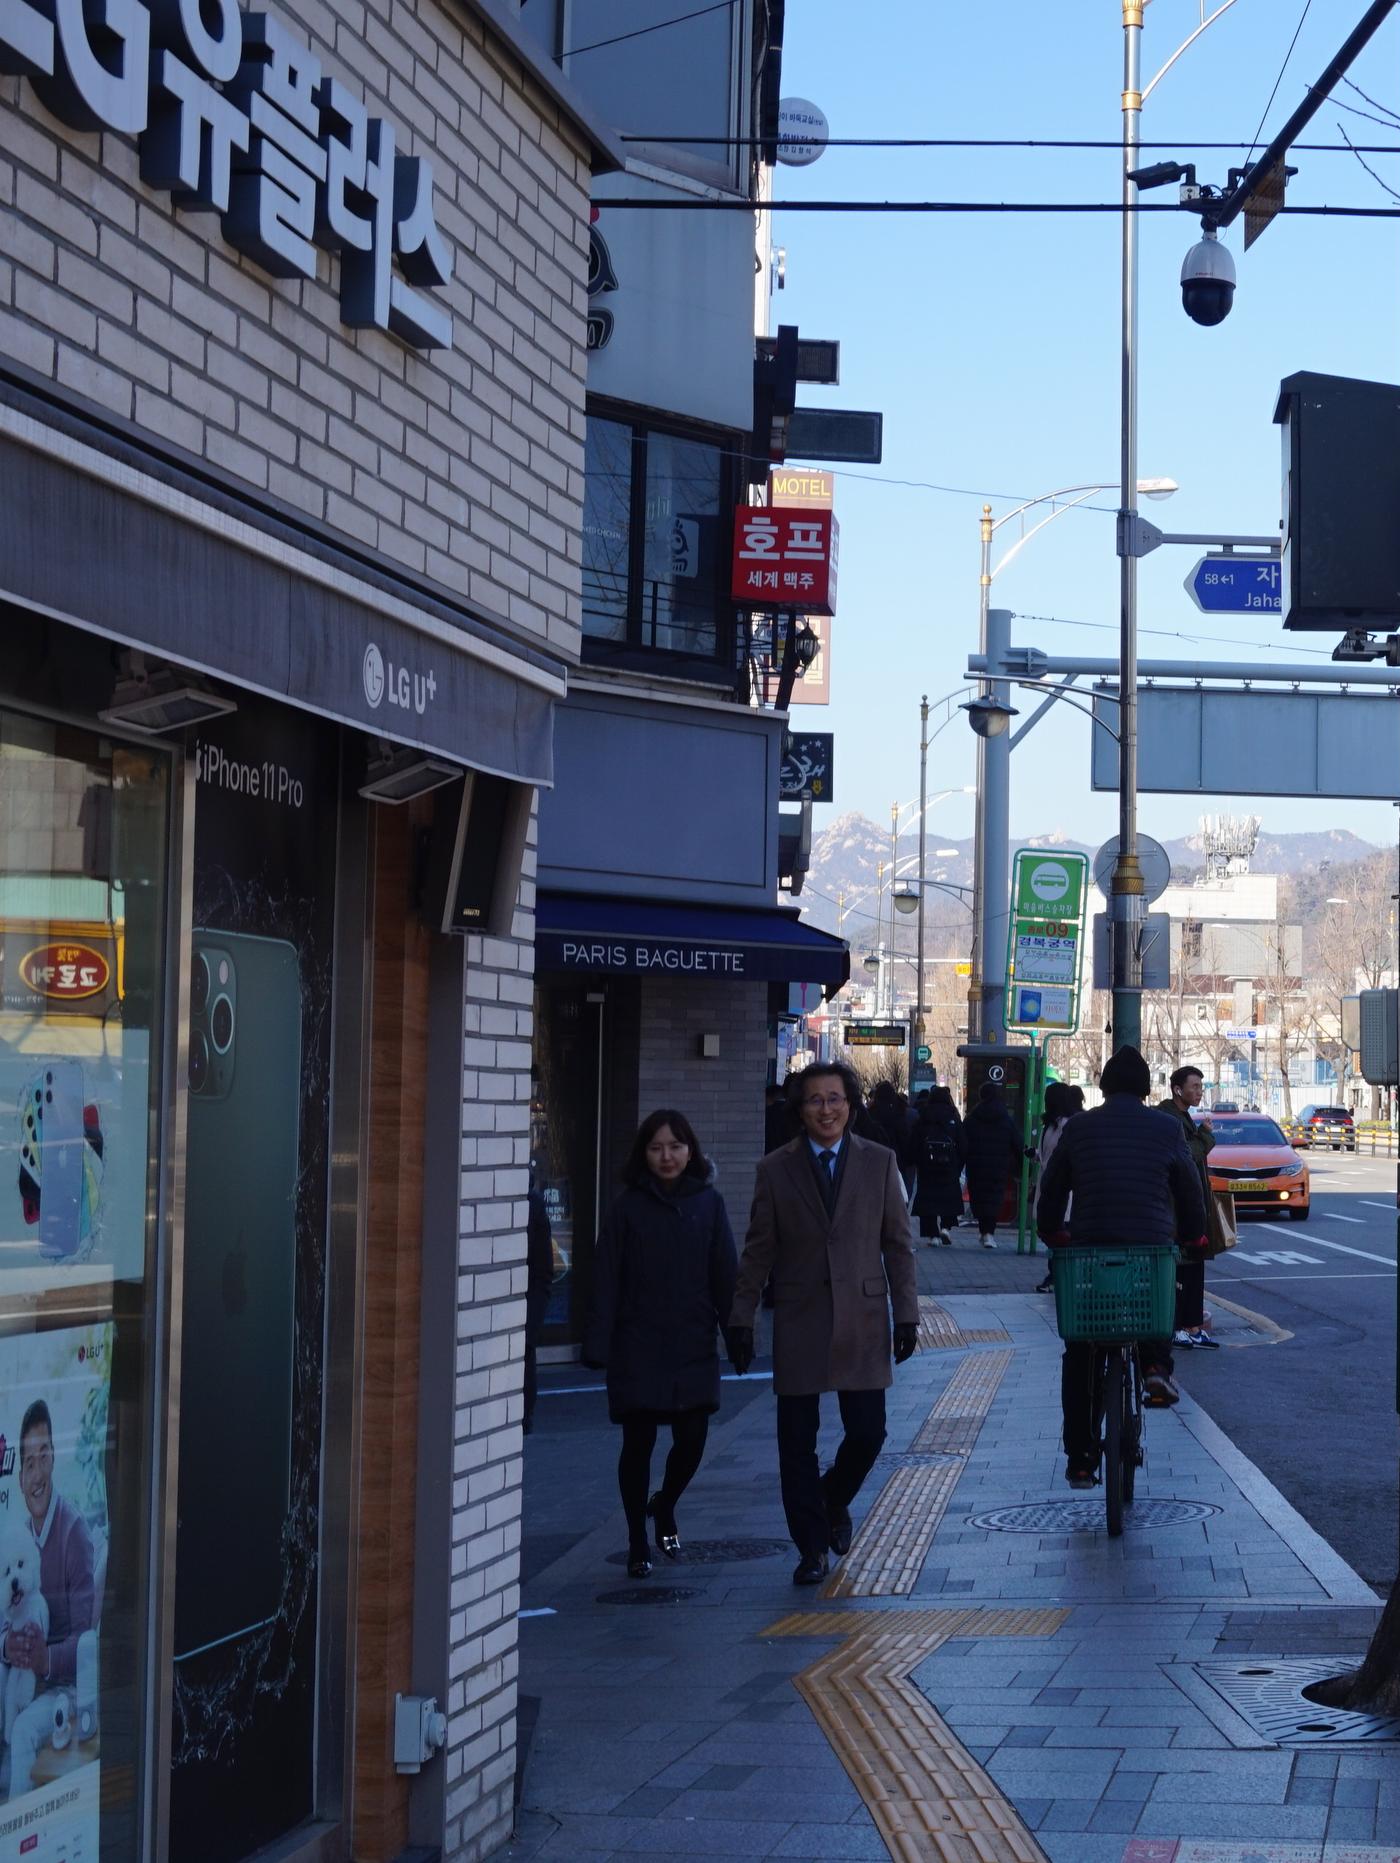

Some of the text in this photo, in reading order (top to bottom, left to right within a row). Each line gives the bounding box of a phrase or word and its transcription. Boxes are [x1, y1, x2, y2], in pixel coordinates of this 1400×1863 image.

[773, 478, 831, 496] MOTEL
[738, 516, 825, 561] 호프
[747, 570, 815, 590] 세계 맥주
[1256, 565, 1280, 589] 자
[388, 662, 437, 715] LG U+
[203, 743, 303, 808] iPhone 11 Pro
[1018, 935, 1076, 949] 경복궁역
[1045, 922, 1069, 938] 09
[562, 943, 745, 973] PARIS BAGUETTE
